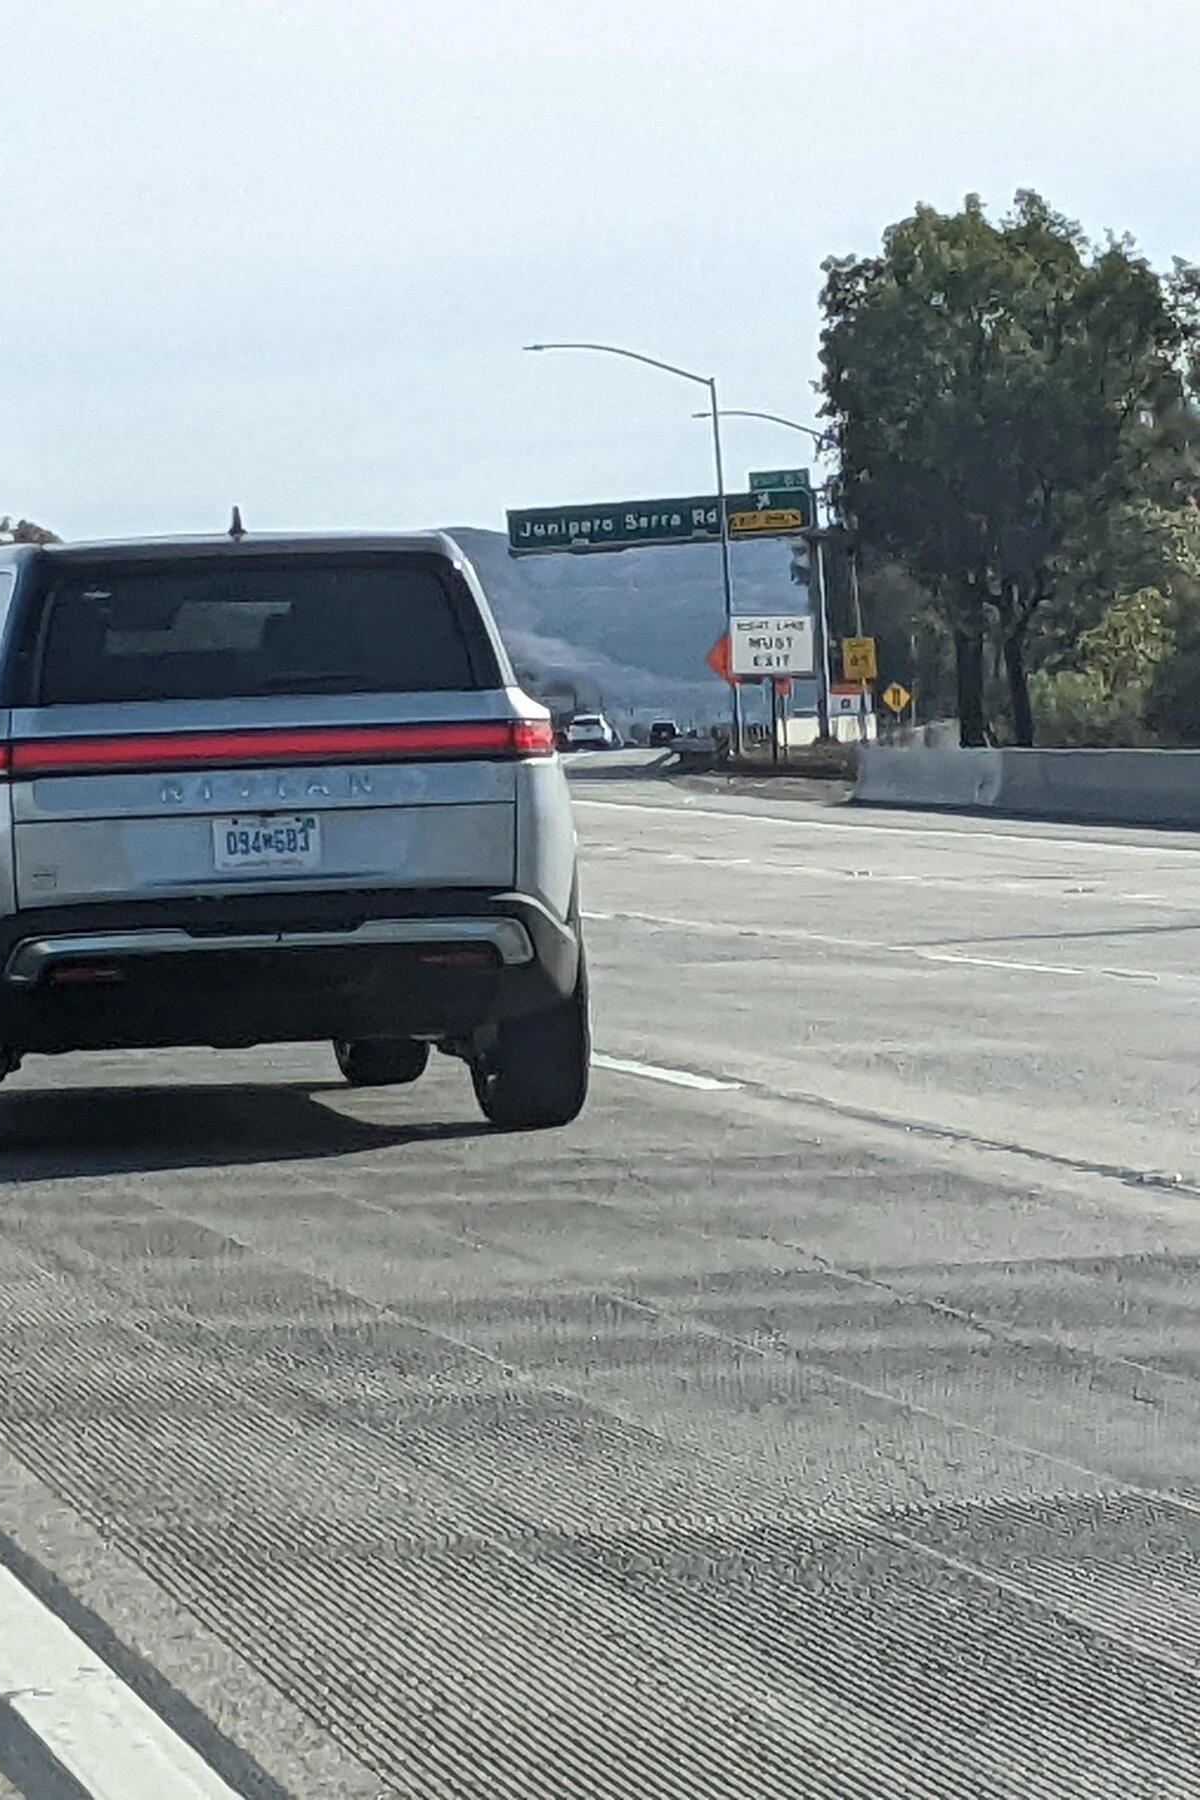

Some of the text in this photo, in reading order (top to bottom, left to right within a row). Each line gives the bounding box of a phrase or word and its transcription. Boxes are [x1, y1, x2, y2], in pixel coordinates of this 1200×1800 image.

[519, 517, 613, 538] Junipero
[624, 513, 681, 531] Serra
[692, 508, 717, 525] Rd
[753, 654, 789, 667] EXIT
